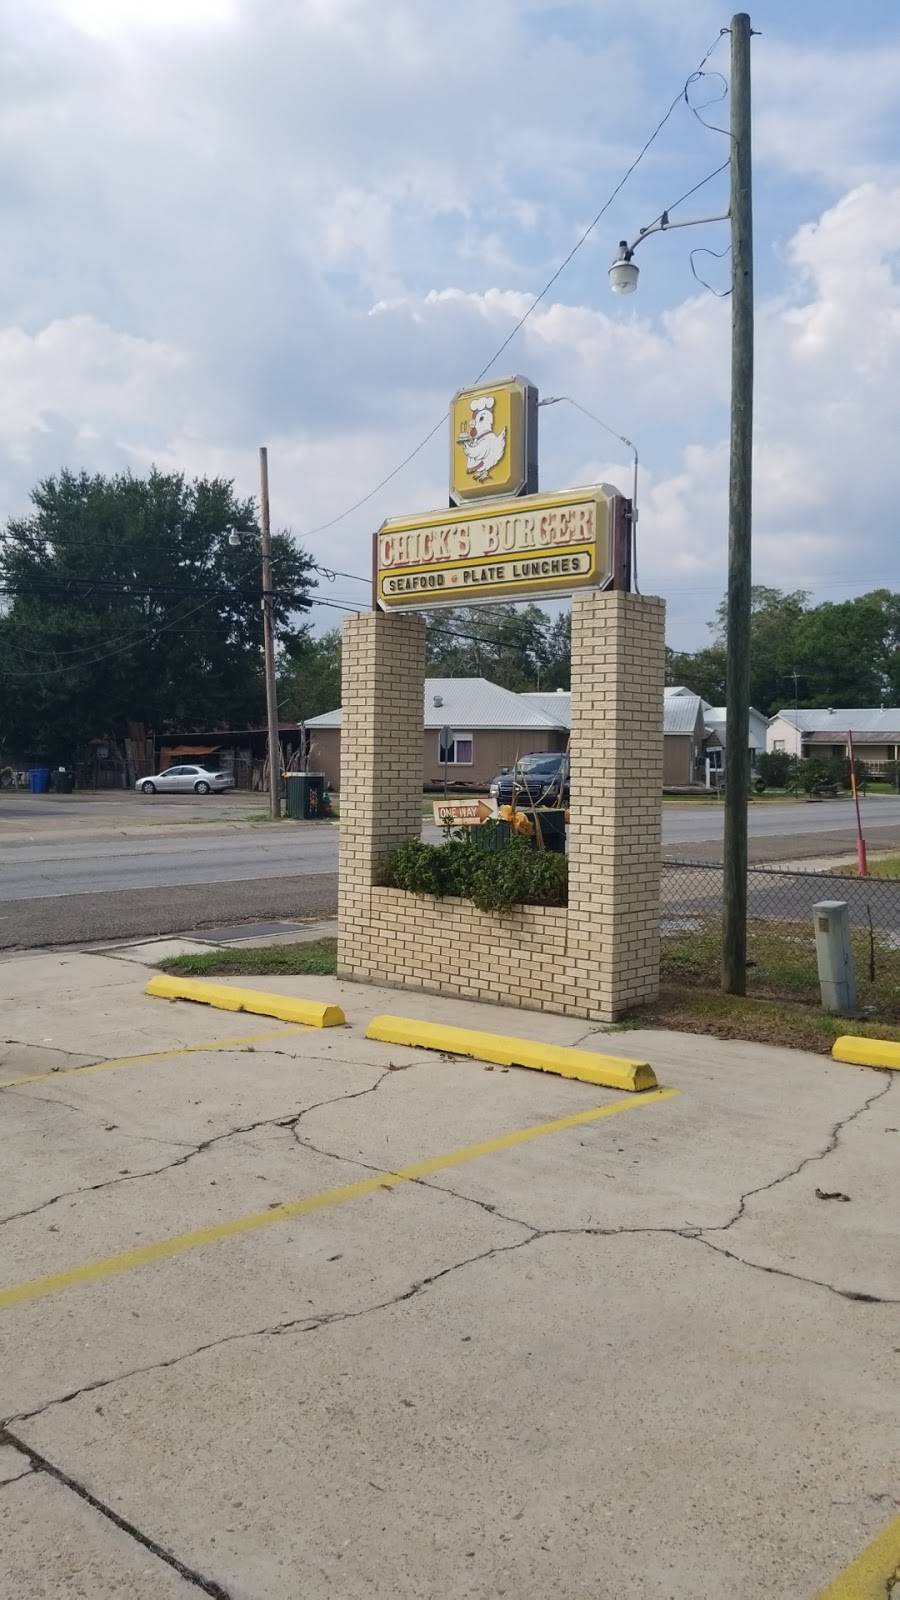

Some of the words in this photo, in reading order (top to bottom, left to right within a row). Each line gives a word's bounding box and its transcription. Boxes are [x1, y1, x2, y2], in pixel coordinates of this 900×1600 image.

[380, 526, 471, 567] CHICK'S
[481, 509, 593, 555] BURGER
[389, 573, 445, 592] SEAFOOD
[463, 566, 505, 584] PLATE
[513, 557, 581, 577] LUNCHES
[440, 807, 457, 818] ONE
[459, 807, 477, 817] WAY
